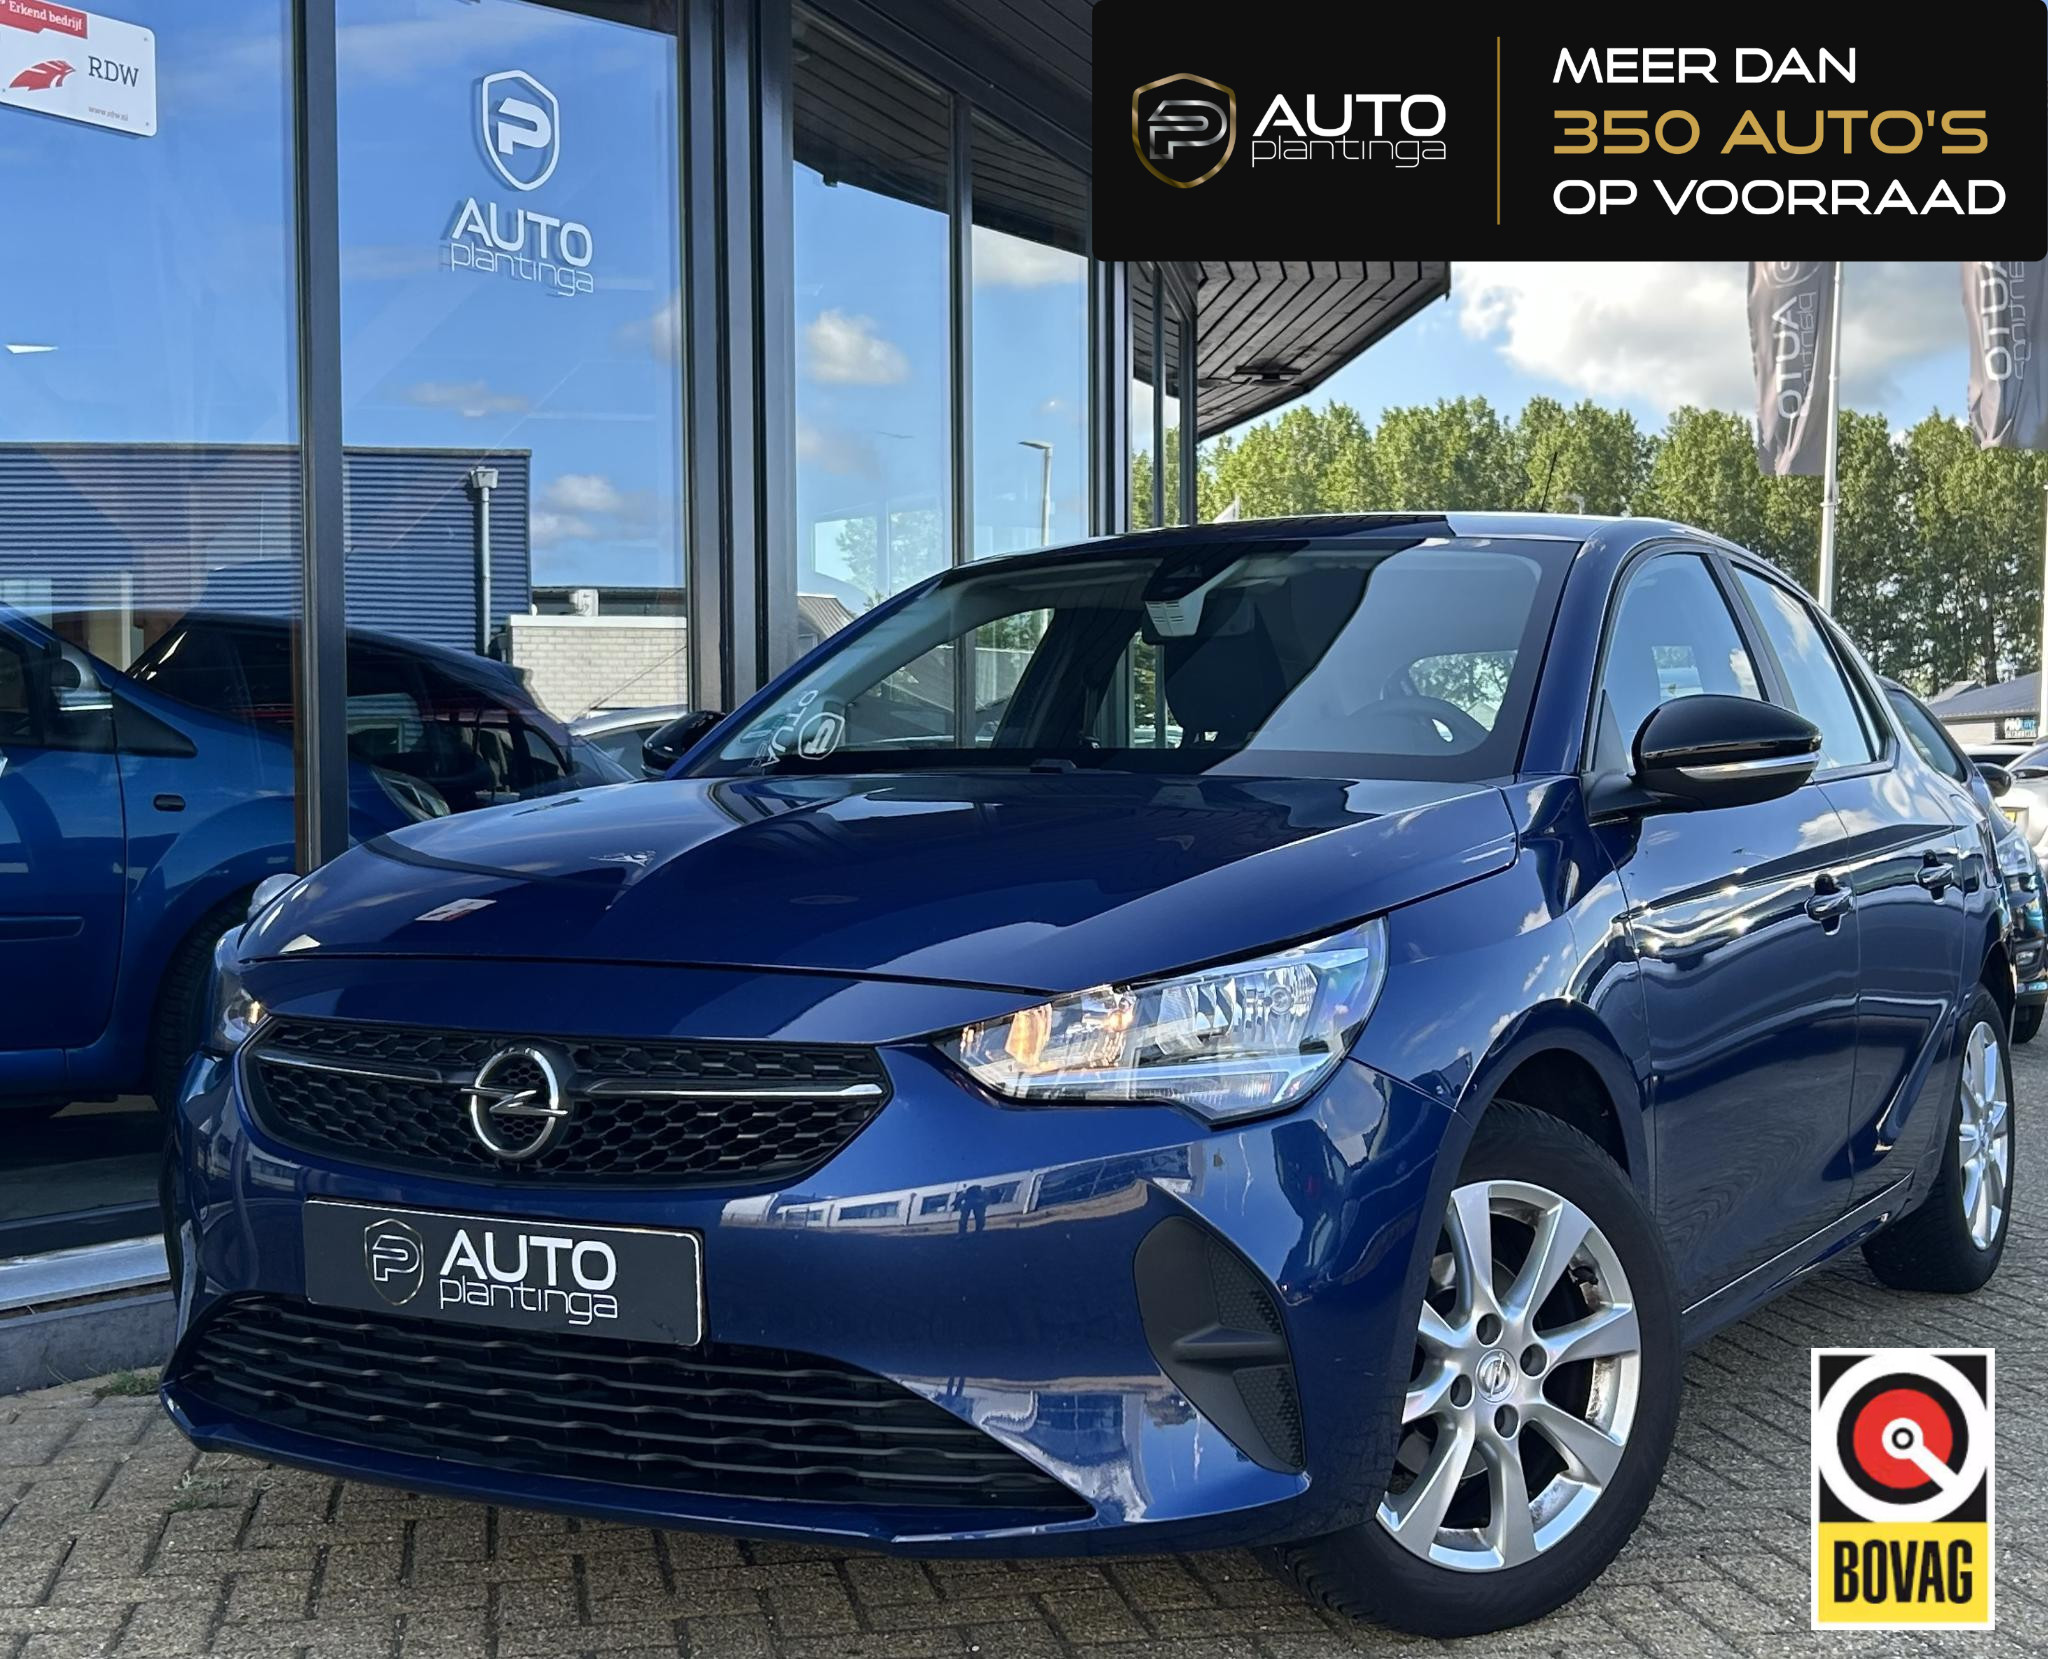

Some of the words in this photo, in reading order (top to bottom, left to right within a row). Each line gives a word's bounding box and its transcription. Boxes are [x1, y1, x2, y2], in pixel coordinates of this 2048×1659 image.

[8, 0, 47, 21] Erkend
[48, 10, 83, 31] bedrijf
[88, 56, 139, 88] RDW
[451, 197, 593, 267] AUTO
[450, 242, 594, 297] plantinga
[439, 1229, 617, 1290] AUTO
[439, 1275, 618, 1326] plantinga
